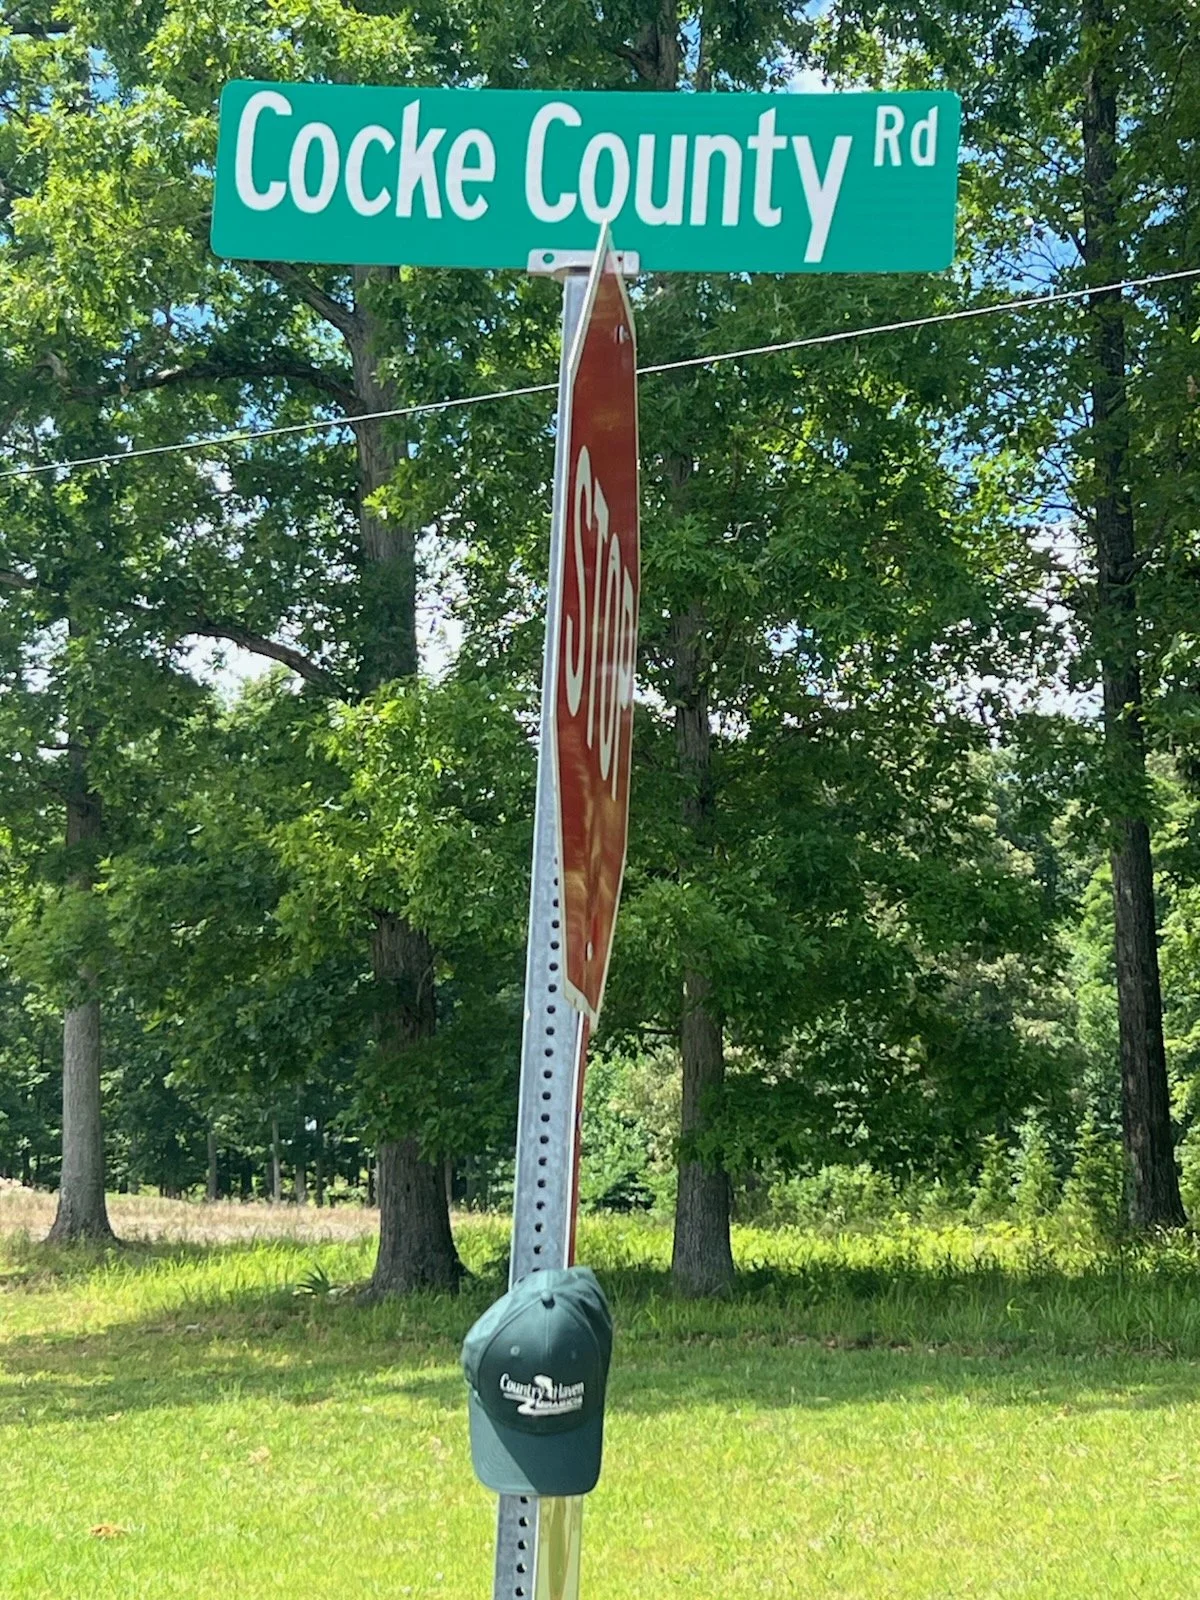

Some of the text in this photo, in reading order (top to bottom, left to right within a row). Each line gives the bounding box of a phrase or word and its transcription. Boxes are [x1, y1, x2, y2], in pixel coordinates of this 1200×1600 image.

[235, 92, 938, 263] Cocke County Rd
[566, 445, 635, 801] STOP
[500, 1373, 544, 1401] Country
